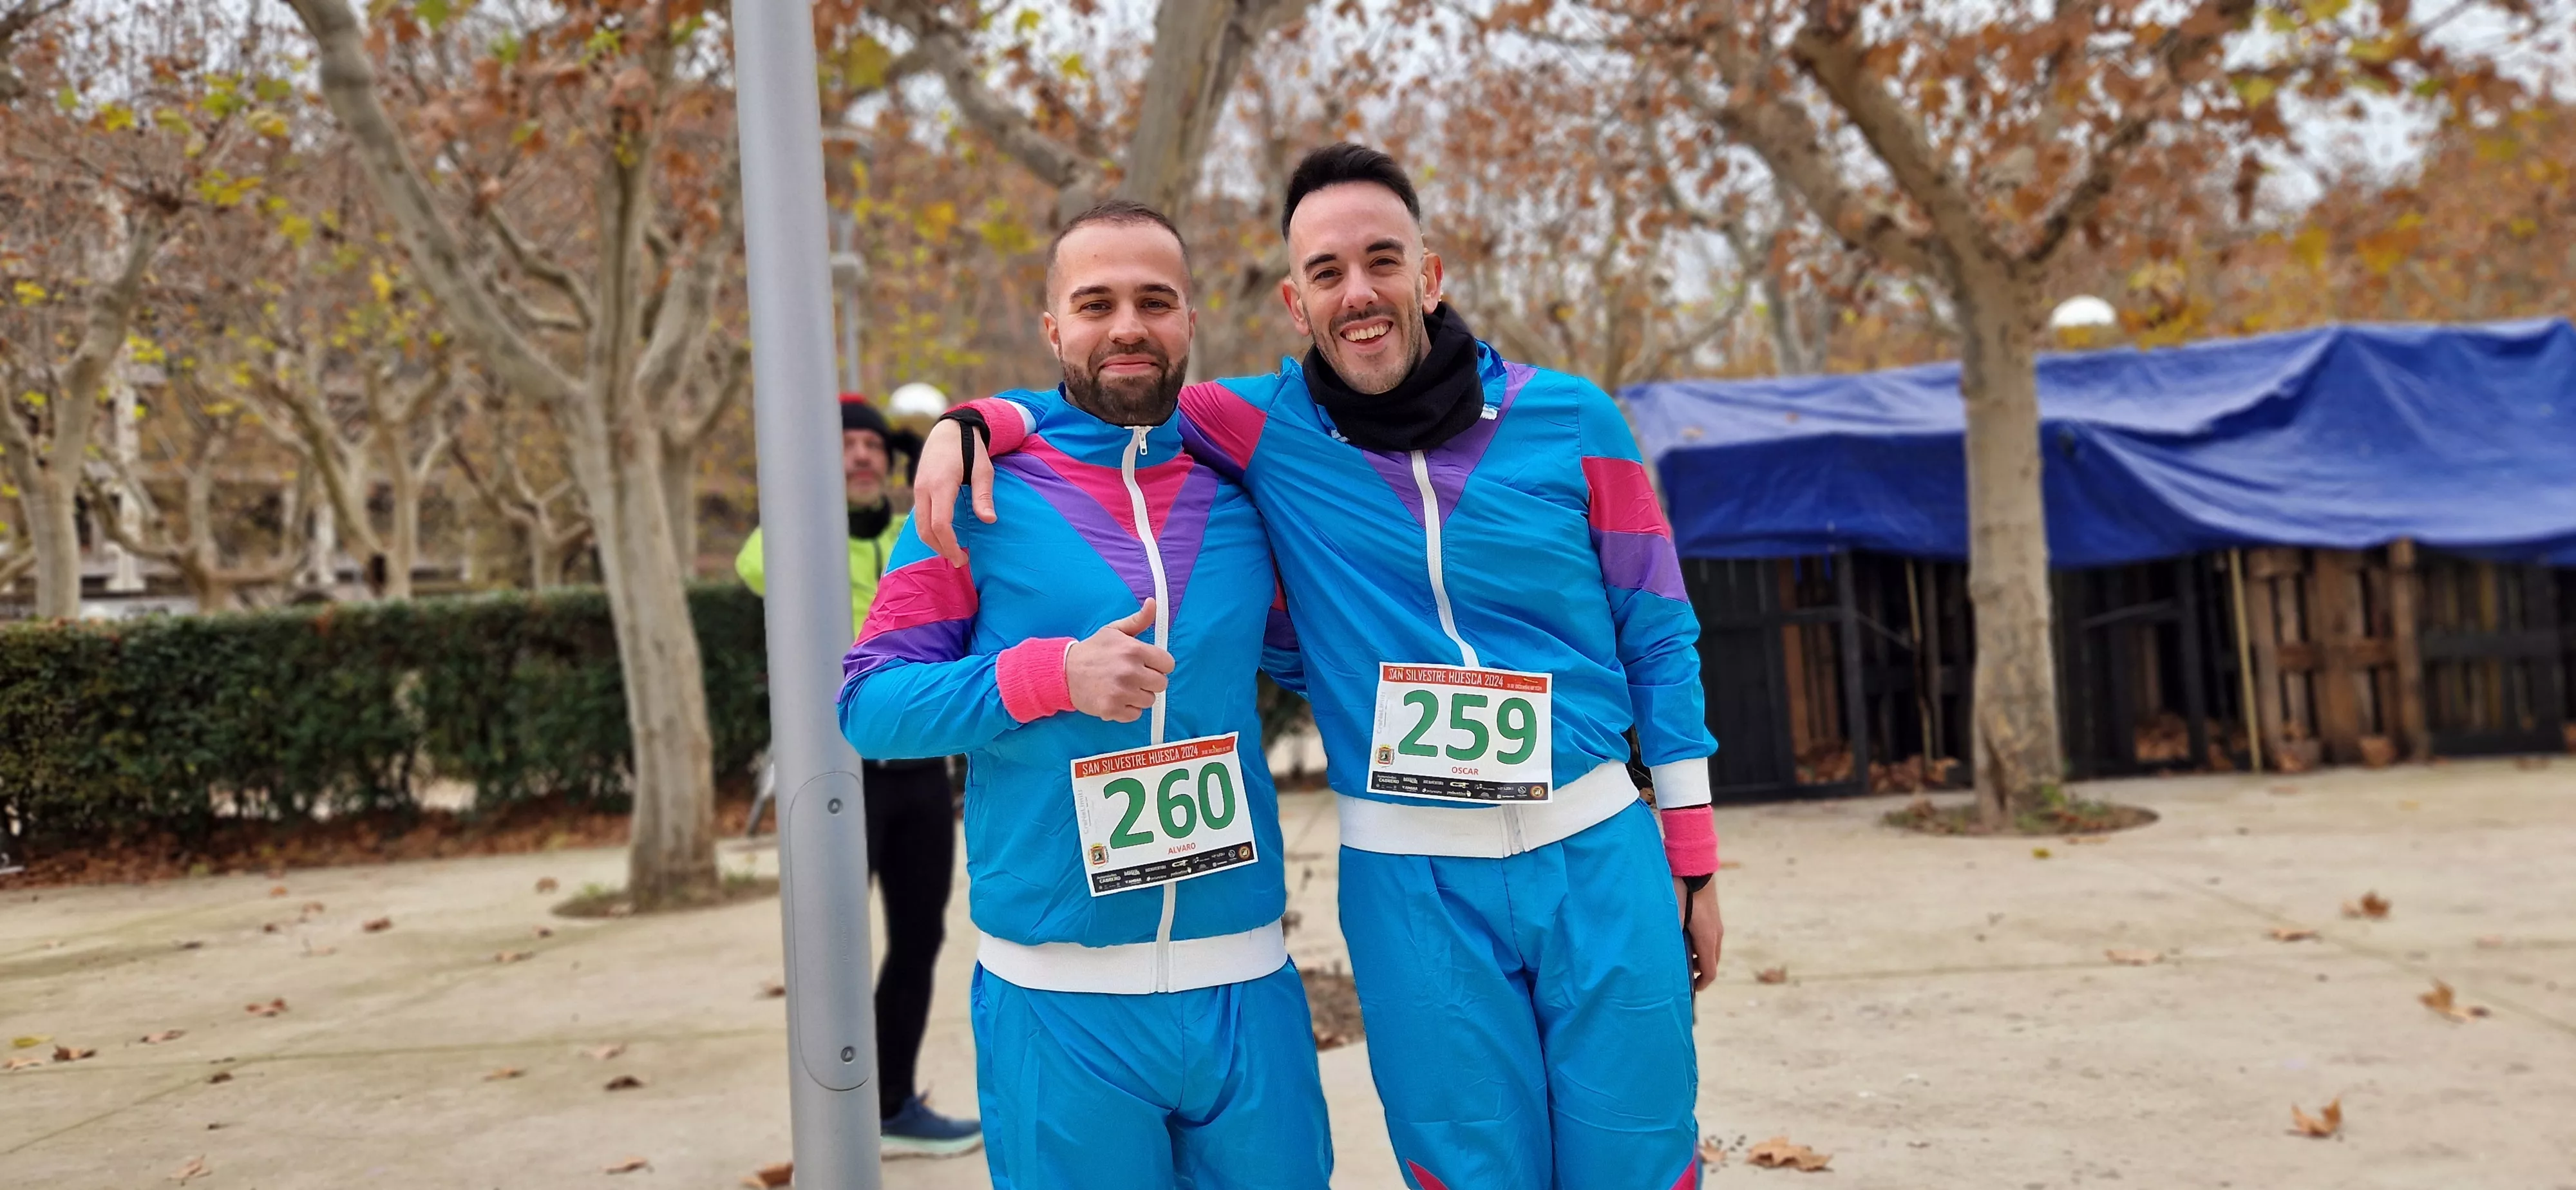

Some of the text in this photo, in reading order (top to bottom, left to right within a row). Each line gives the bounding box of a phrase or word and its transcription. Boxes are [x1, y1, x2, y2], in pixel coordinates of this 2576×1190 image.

[1388, 668, 1403, 680] SAN
[1406, 669, 1446, 683] SILVESTRE
[1448, 672, 1482, 685] HUESCA
[1484, 674, 1504, 687] 2024
[1398, 690, 1537, 765] 259
[1082, 763, 1100, 775] SAN
[1102, 755, 1146, 773] SILVESTRE
[1149, 749, 1180, 764] HUESCA
[1181, 745, 1198, 758] 2024
[1452, 766, 1479, 775] OSCAR
[1103, 762, 1236, 849] 260
[1168, 843, 1196, 855] ALVARO
